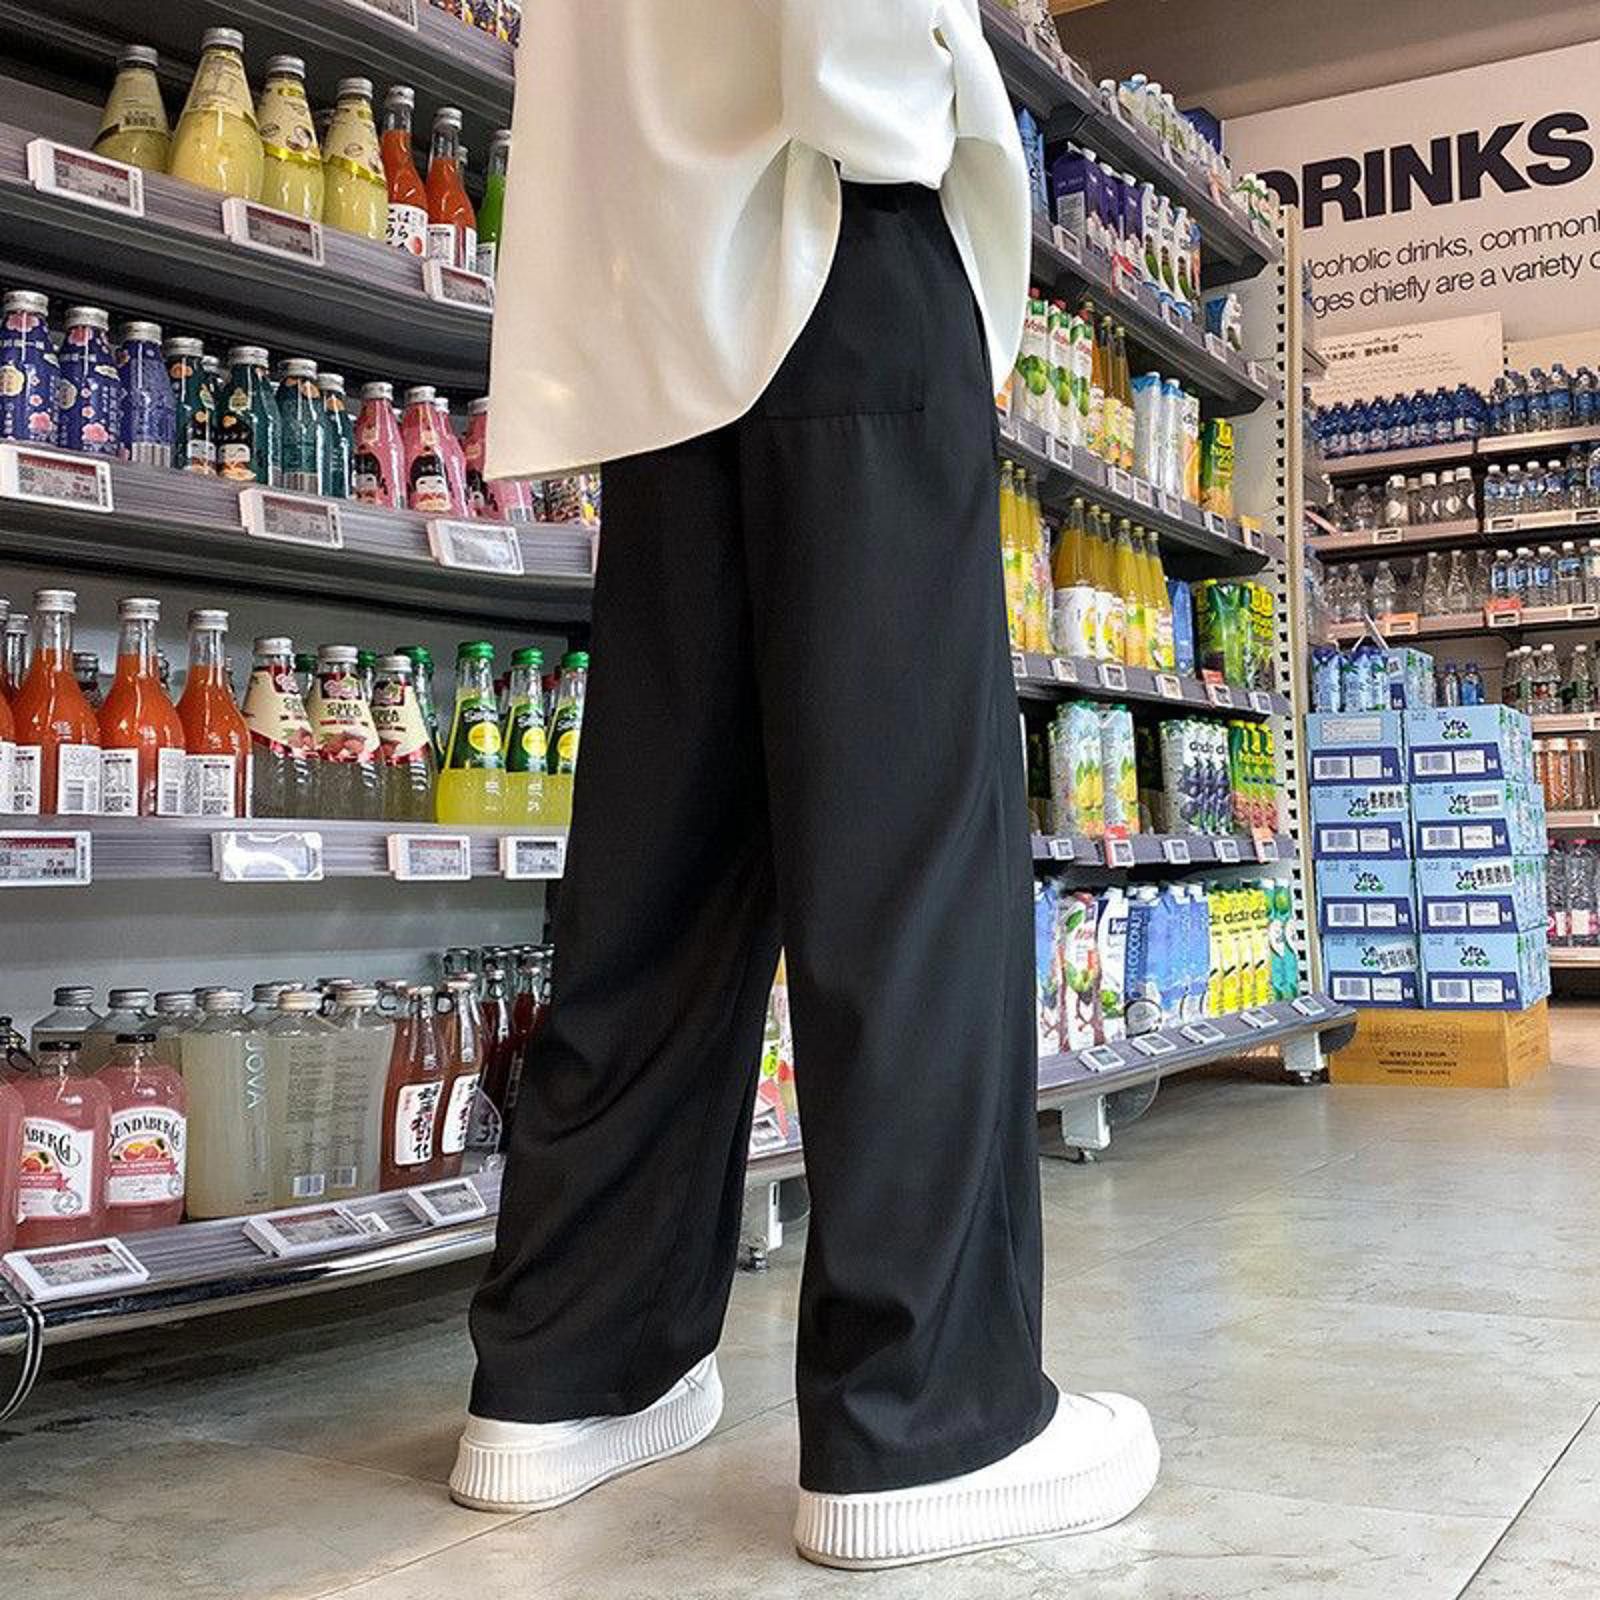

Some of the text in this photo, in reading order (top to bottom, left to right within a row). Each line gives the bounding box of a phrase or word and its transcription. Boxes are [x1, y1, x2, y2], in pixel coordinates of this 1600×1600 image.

[1397, 236, 1473, 266] drinks,
[1360, 276, 1431, 307] chiefly
[1436, 272, 1474, 295] are
[1481, 269, 1497, 287] a
[1502, 252, 1583, 282] variety
